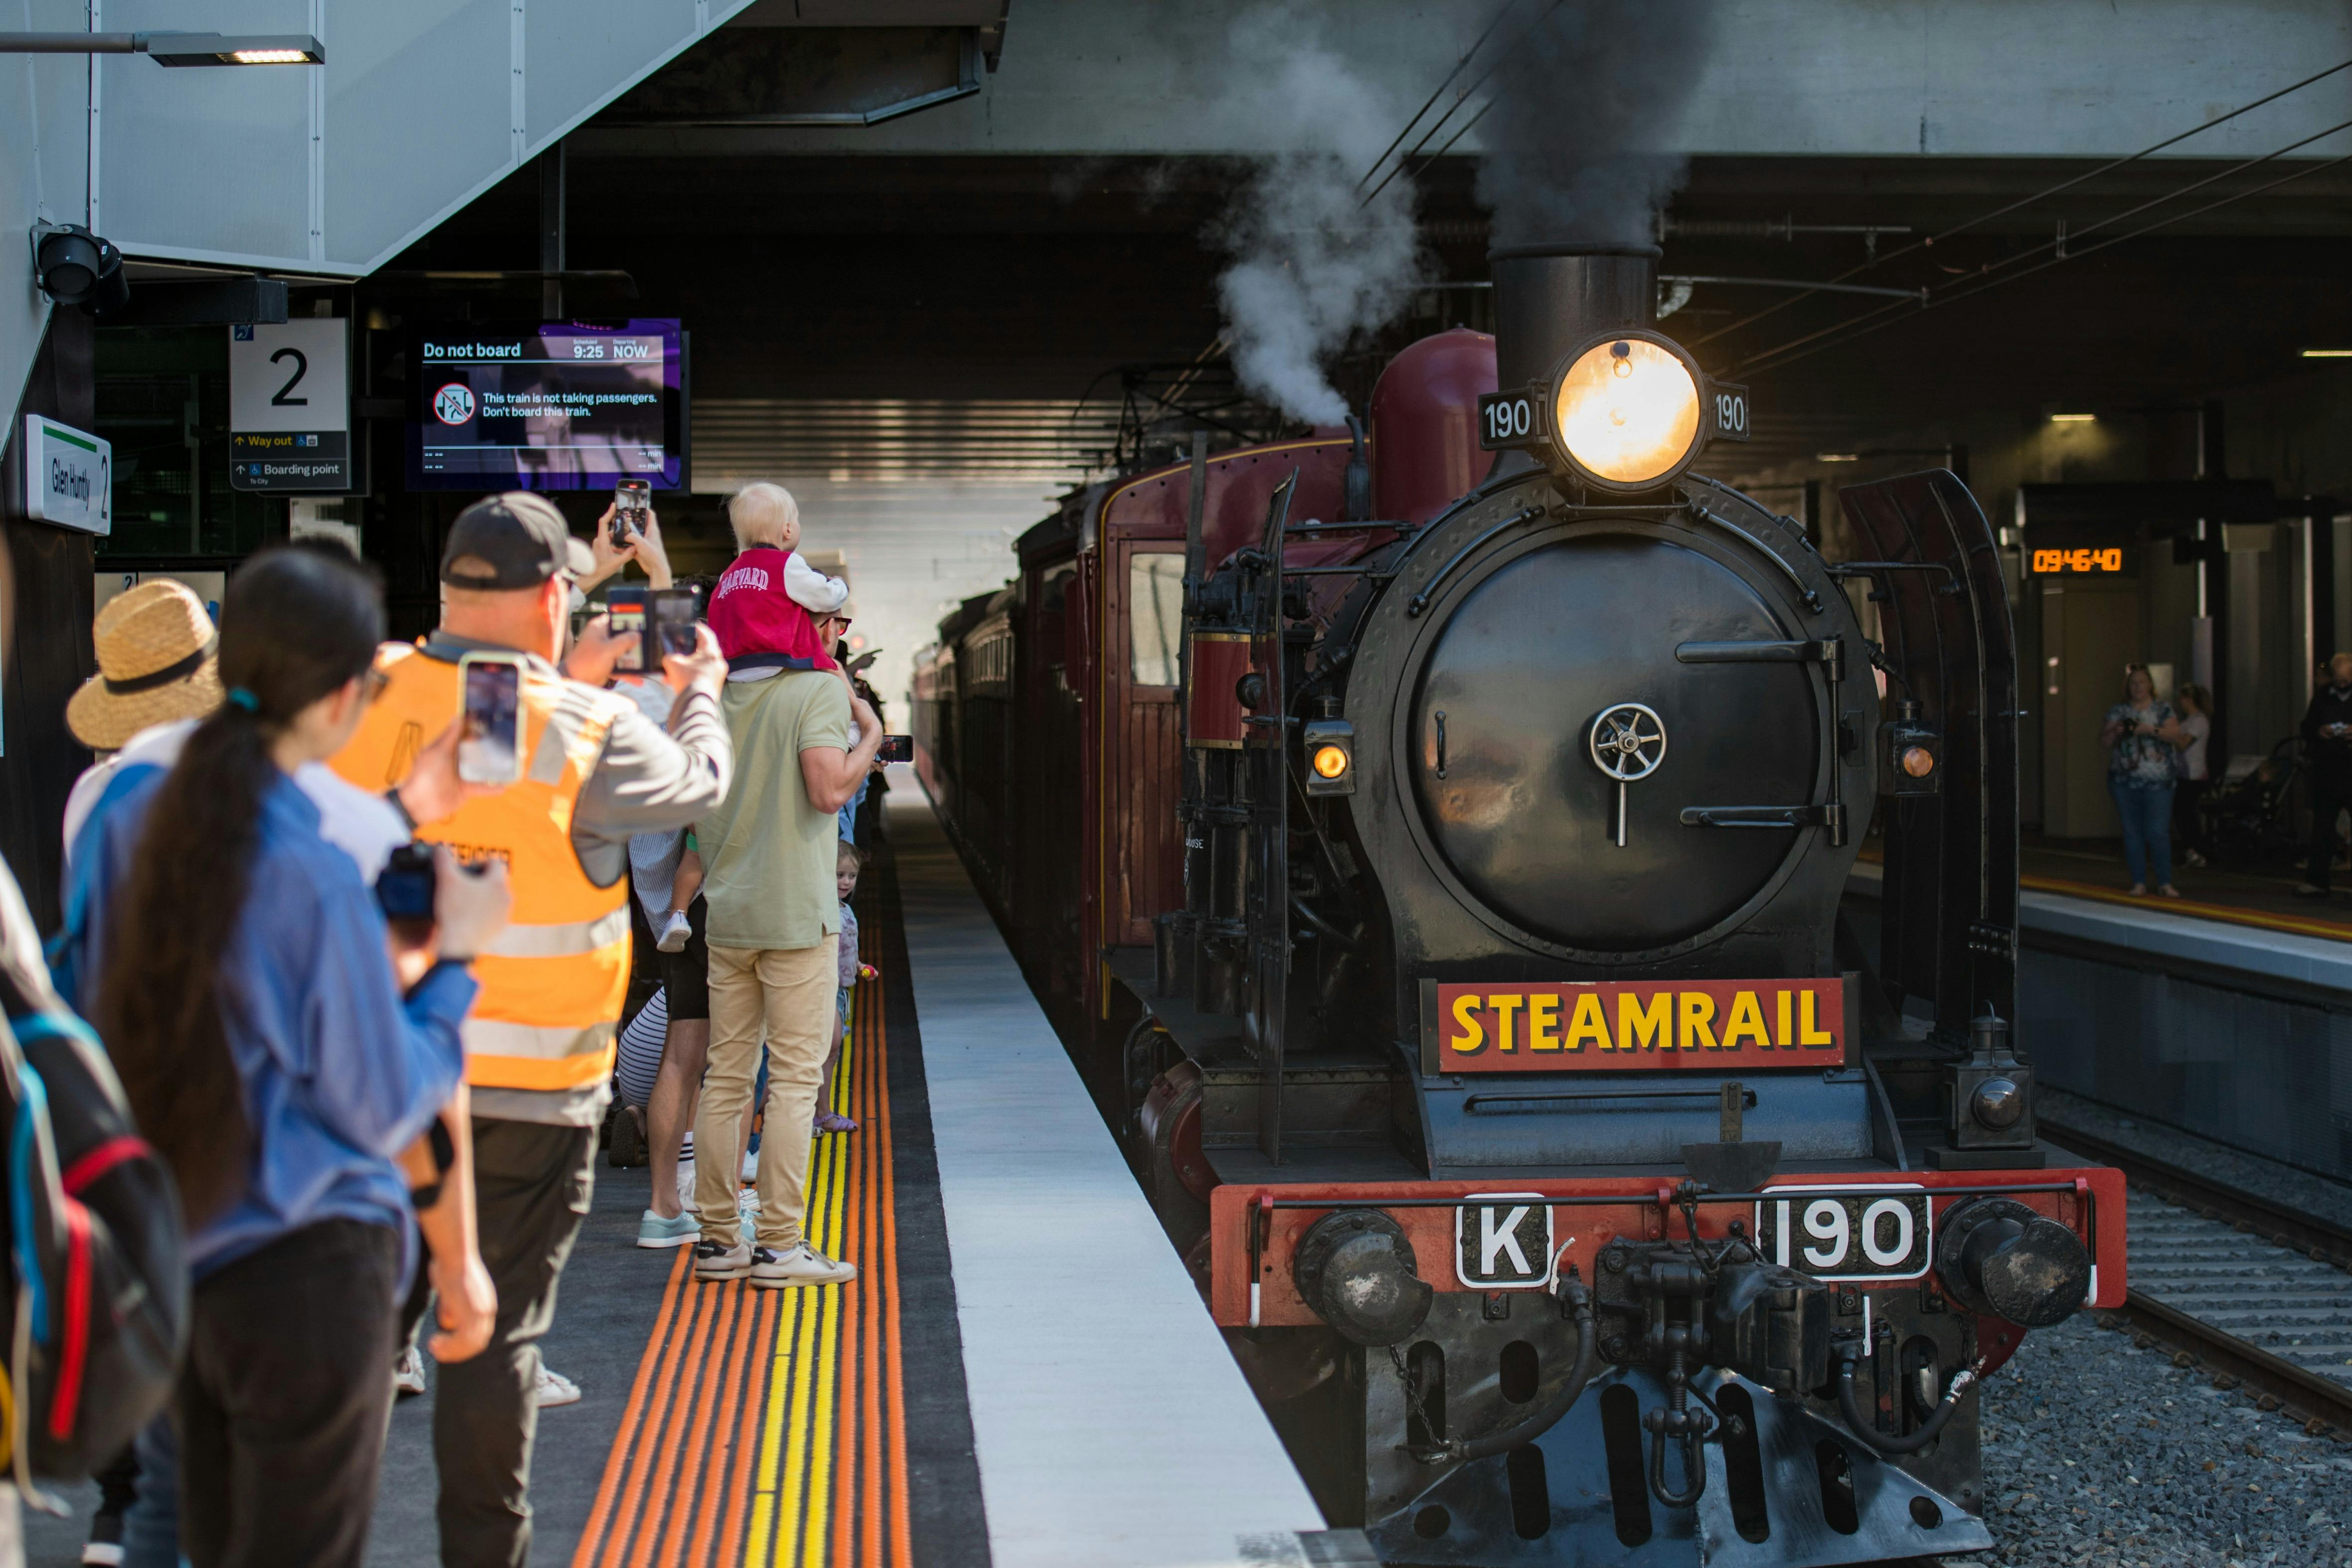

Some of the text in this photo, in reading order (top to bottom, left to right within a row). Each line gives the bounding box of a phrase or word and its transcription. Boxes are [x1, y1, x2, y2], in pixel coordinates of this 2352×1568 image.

[424, 342, 521, 357] Do not board
[574, 345, 604, 359] 9:25
[613, 345, 648, 359] NOW
[270, 348, 308, 406] 2
[483, 392, 657, 405] This train is not taking passengers.
[483, 406, 591, 417] Don't board this train.
[1716, 394, 1744, 431] 190
[1485, 399, 1530, 438] 190
[248, 436, 292, 448] Way out
[264, 464, 339, 477] Boarding point
[52, 458, 90, 512] Glen Huntly
[101, 455, 108, 519] 2
[2033, 548, 2121, 572] 09:46:40
[125, 576, 132, 590] 2
[718, 567, 768, 599] HARVARD
[1451, 990, 1833, 1052] STEAMRAIL
[1481, 1206, 1532, 1275] K
[1776, 1198, 1913, 1268] 190
